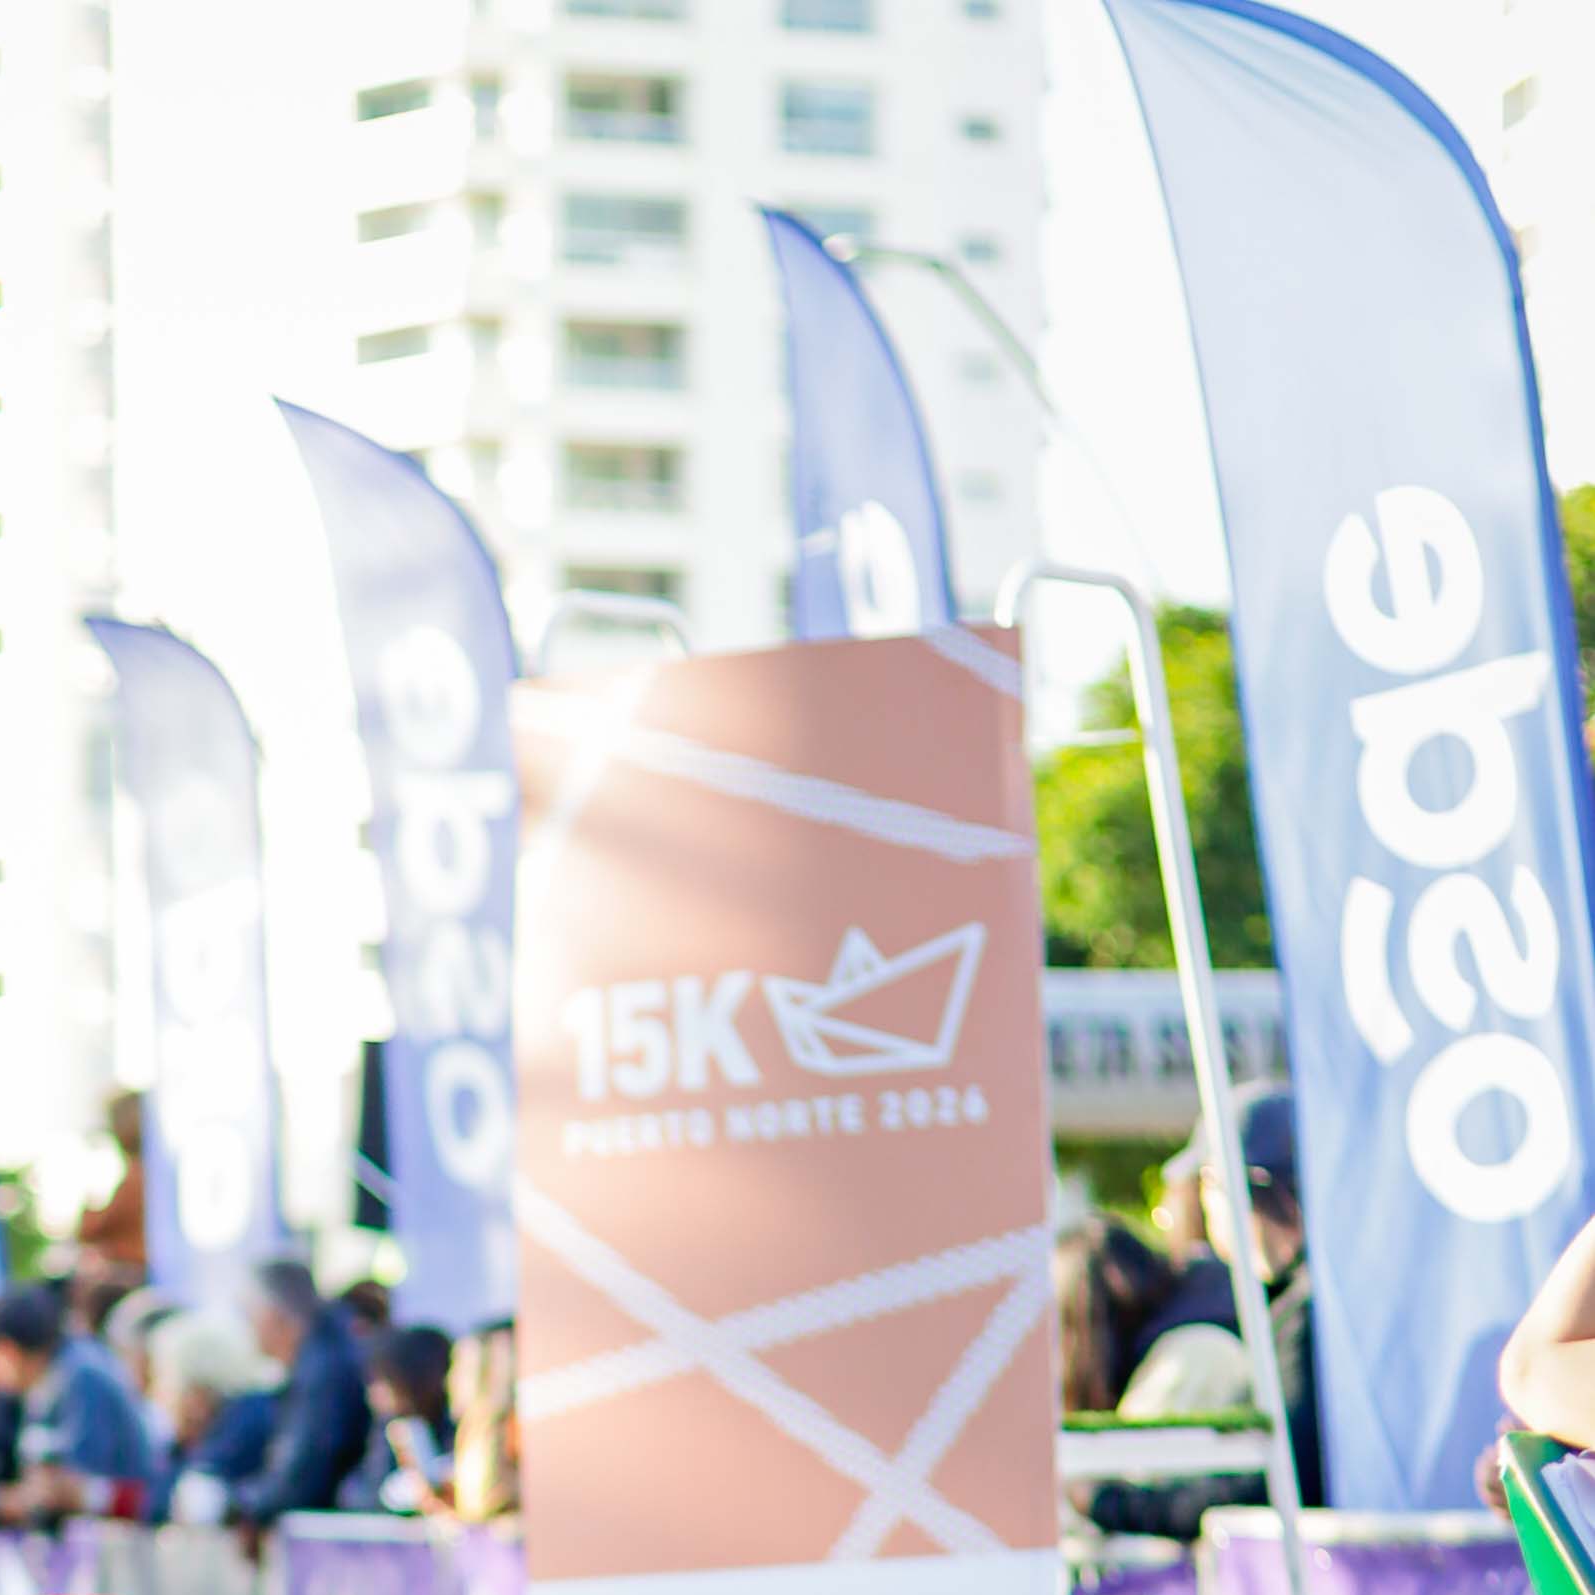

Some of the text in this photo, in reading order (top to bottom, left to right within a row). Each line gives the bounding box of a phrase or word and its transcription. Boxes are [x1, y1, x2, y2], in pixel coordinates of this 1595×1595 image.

[563, 970, 762, 1100] 15K
[562, 1108, 715, 1162] PUERTO
[725, 1093, 864, 1143] NORTE
